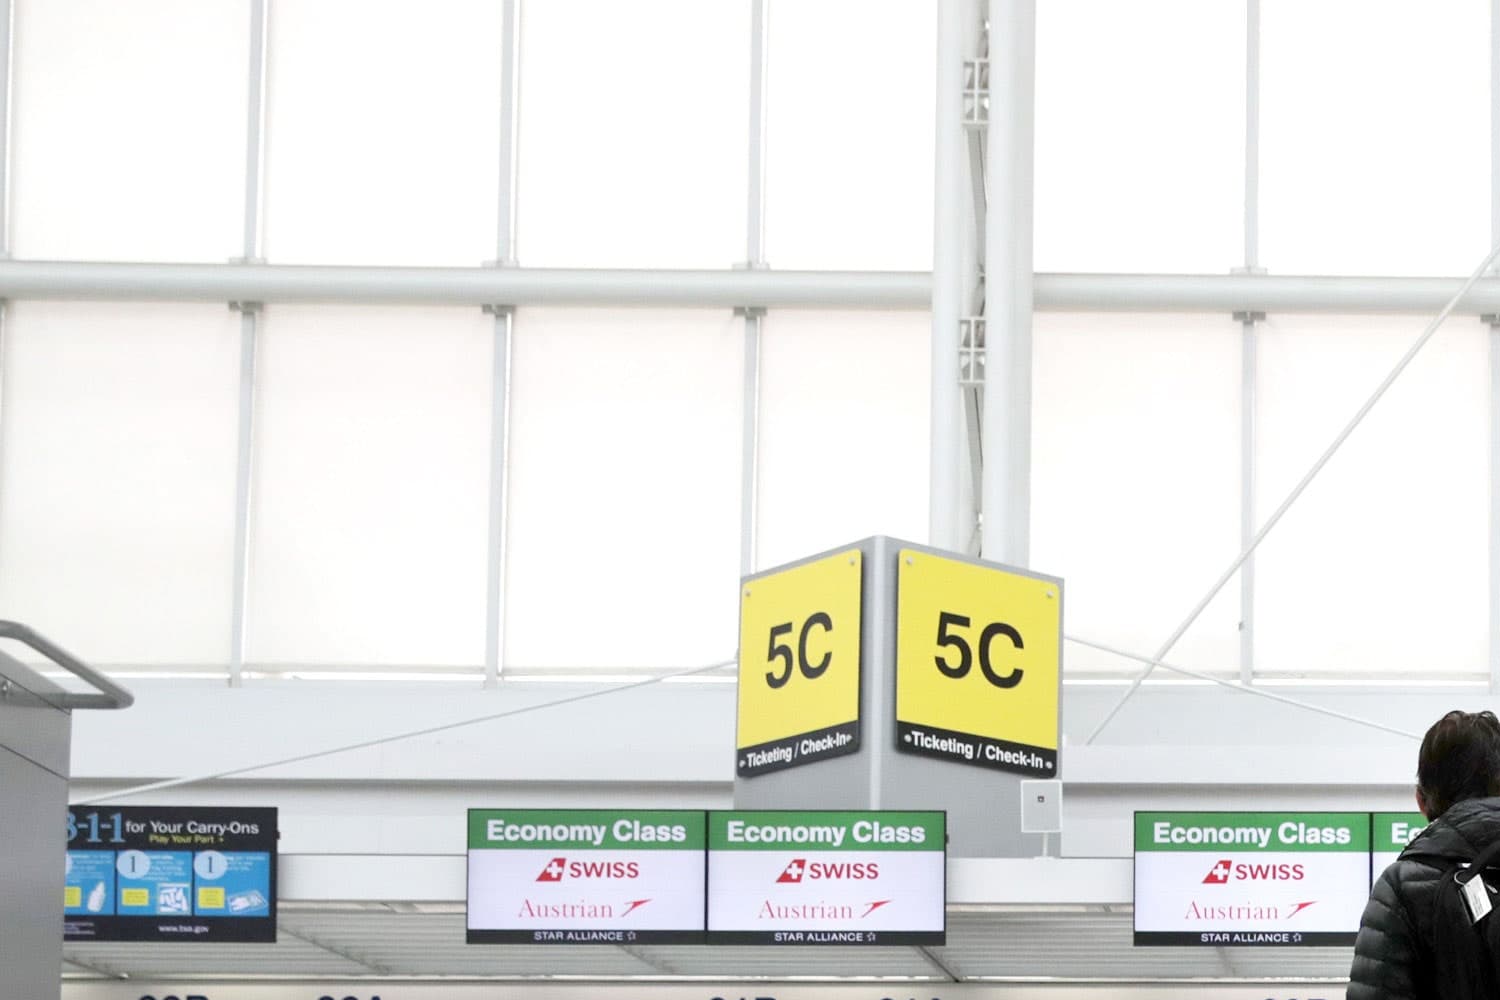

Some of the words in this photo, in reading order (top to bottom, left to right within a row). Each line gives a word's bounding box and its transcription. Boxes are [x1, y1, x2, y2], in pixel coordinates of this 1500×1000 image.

[765, 611, 833, 689] 5C
[934, 611, 1025, 689] 5C
[746, 745, 793, 768] Ticketing
[800, 733, 846, 755] Check-In
[911, 730, 974, 758] Ticketing
[985, 745, 1043, 769] Check-In
[125, 821, 145, 833] for
[150, 821, 183, 833] Your
[187, 821, 259, 835] Carry-Ons
[486, 819, 606, 845] Economy
[612, 819, 686, 842] Class
[727, 820, 846, 846] Economy
[852, 820, 925, 843] Class
[1153, 821, 1272, 847] Economy
[1277, 821, 1351, 844] Class
[569, 861, 639, 879] SWISS
[810, 862, 879, 880] SWISS
[1235, 863, 1304, 881] SWISS
[518, 898, 613, 918] Austrian
[758, 900, 852, 919] Austrian
[1184, 901, 1278, 920] Austrian
[534, 931, 565, 941] STAR
[567, 931, 623, 941] ALLIANCE
[774, 932, 805, 942] STAR
[808, 932, 864, 942] ALLIANCE
[1201, 932, 1232, 942] STAR
[1234, 932, 1289, 942] ALLIANCE
